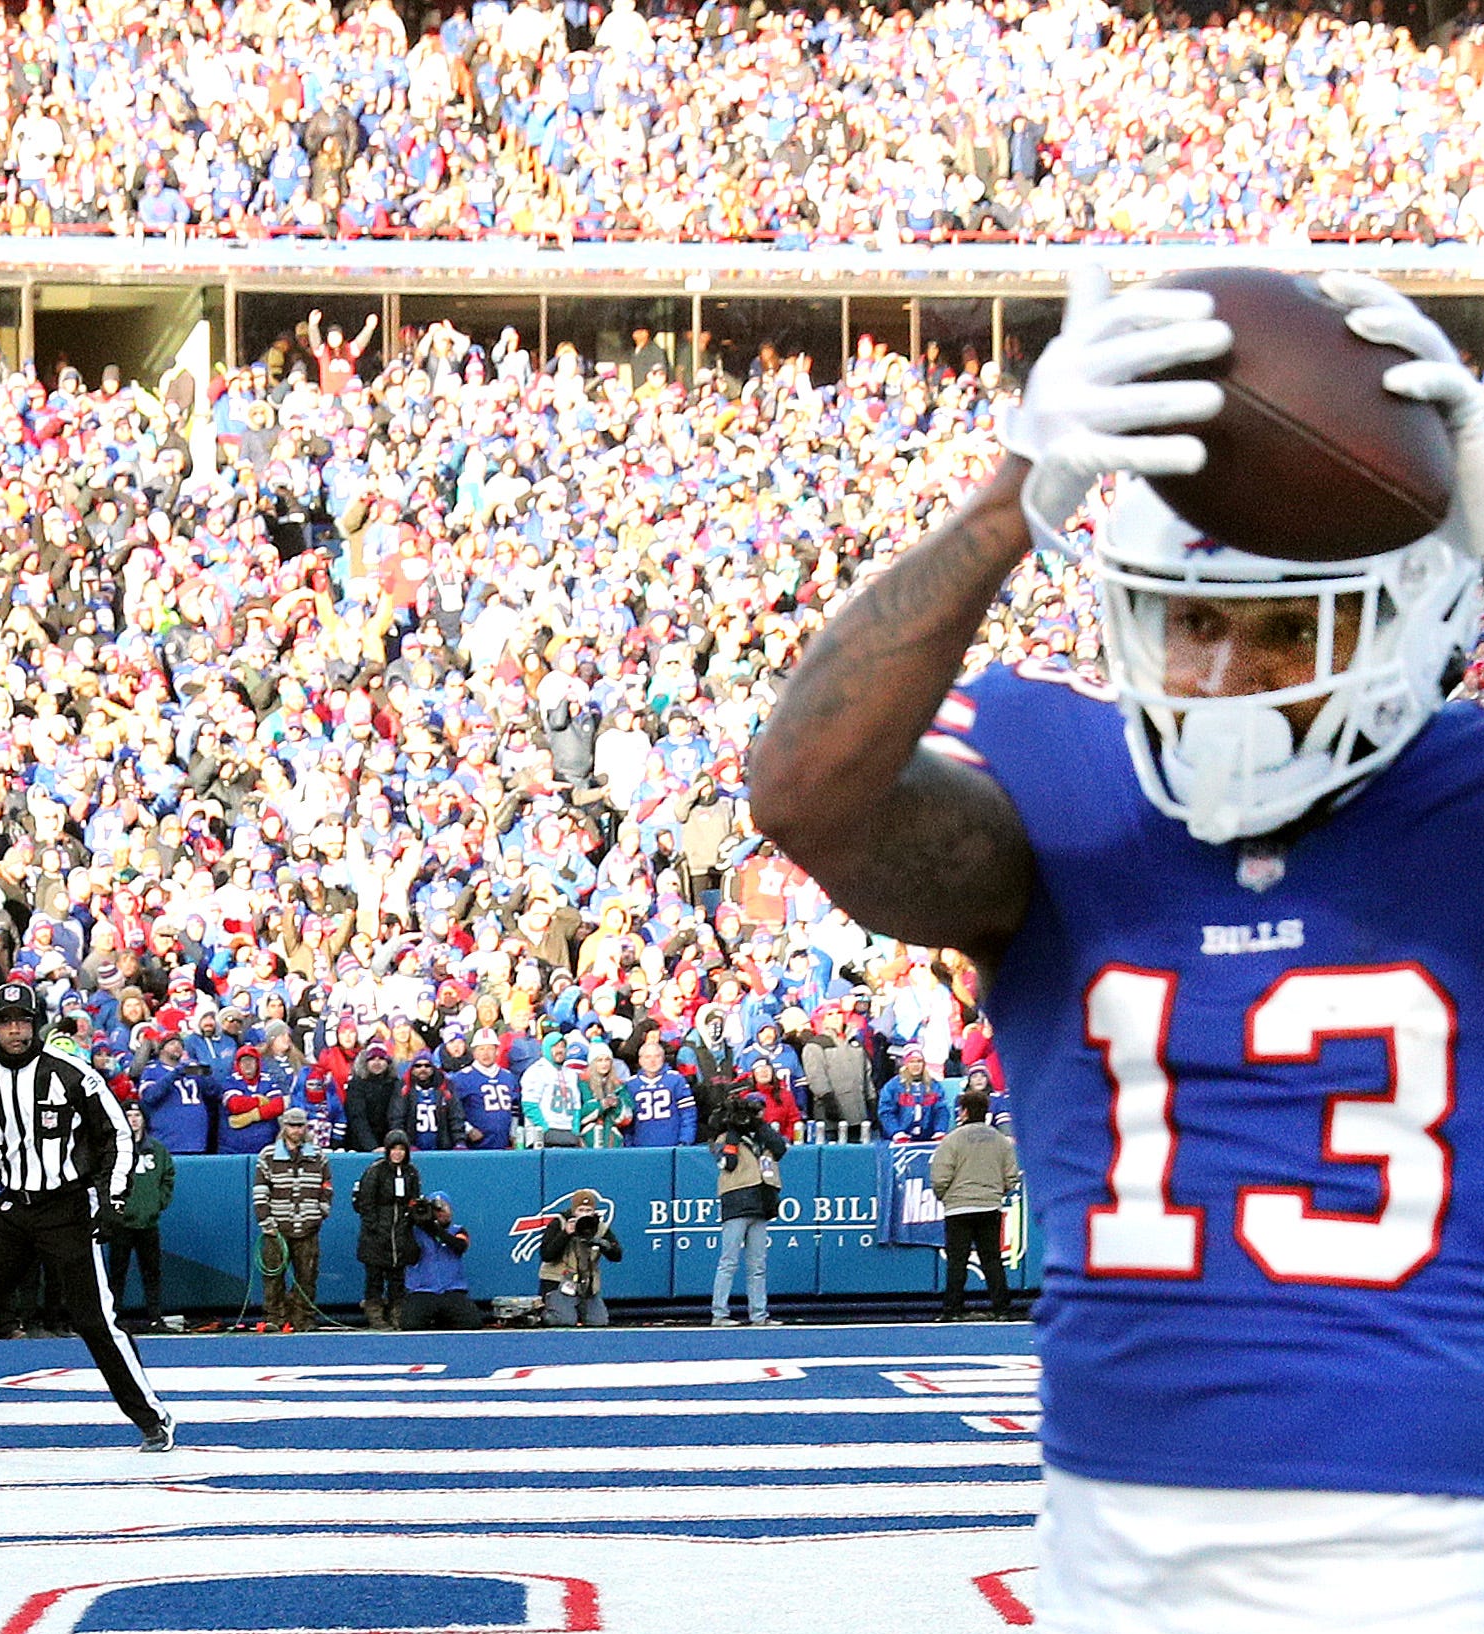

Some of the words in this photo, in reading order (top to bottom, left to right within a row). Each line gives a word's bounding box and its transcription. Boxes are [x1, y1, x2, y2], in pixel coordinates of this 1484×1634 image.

[1199, 918, 1305, 956] BILLS
[173, 1077, 201, 1105] 17
[479, 1084, 513, 1112] 26
[635, 1088, 672, 1122] 32
[1082, 960, 1457, 1289] 13
